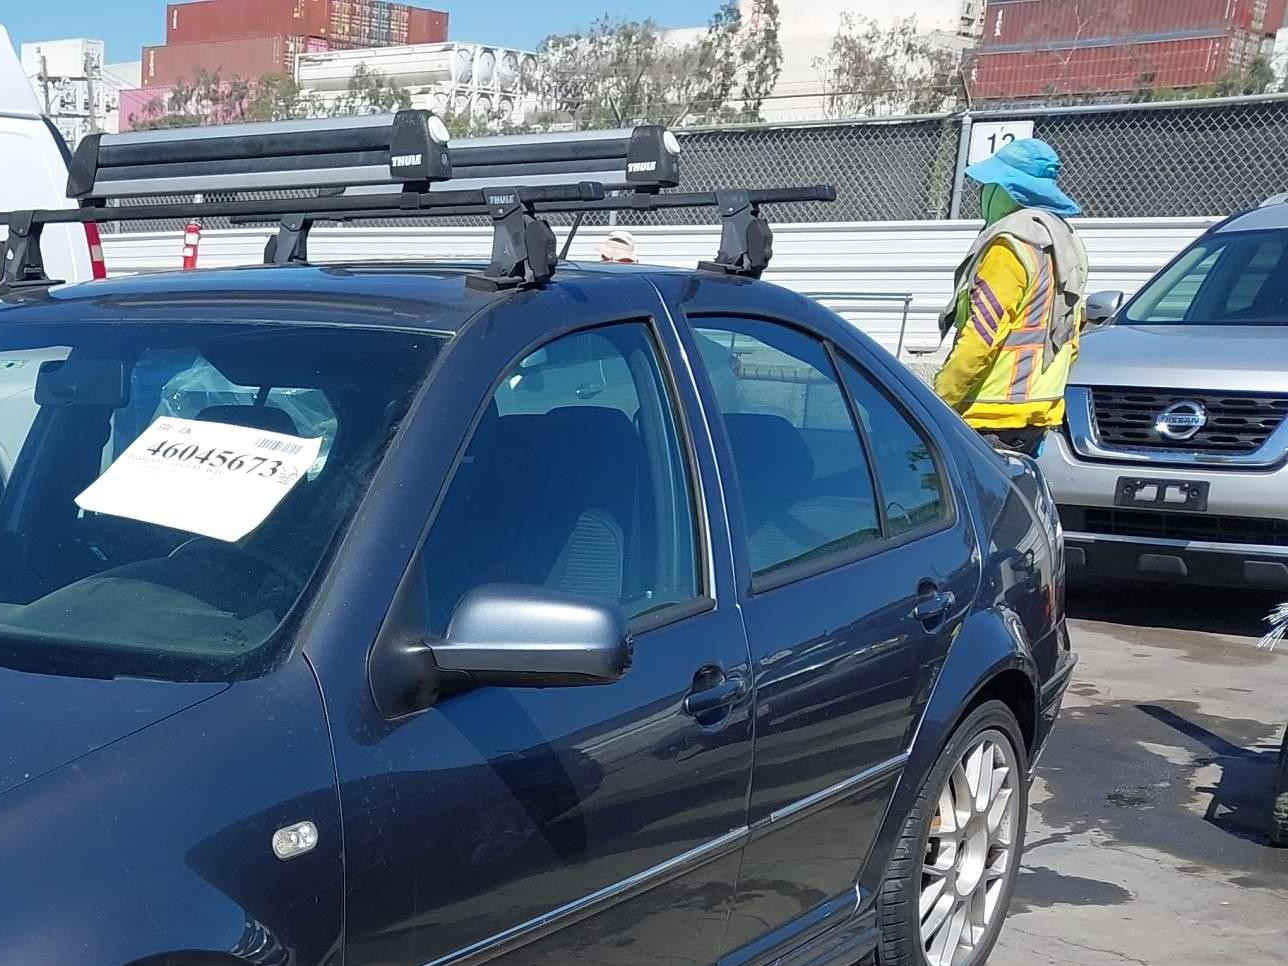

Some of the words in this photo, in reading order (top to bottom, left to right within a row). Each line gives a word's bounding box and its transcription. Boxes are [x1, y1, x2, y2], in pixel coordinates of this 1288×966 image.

[392, 154, 422, 167] THULE
[627, 161, 657, 173] THULE
[489, 194, 515, 205] THULE
[1161, 415, 1200, 424] NISSAN
[146, 440, 283, 477] 46045673
